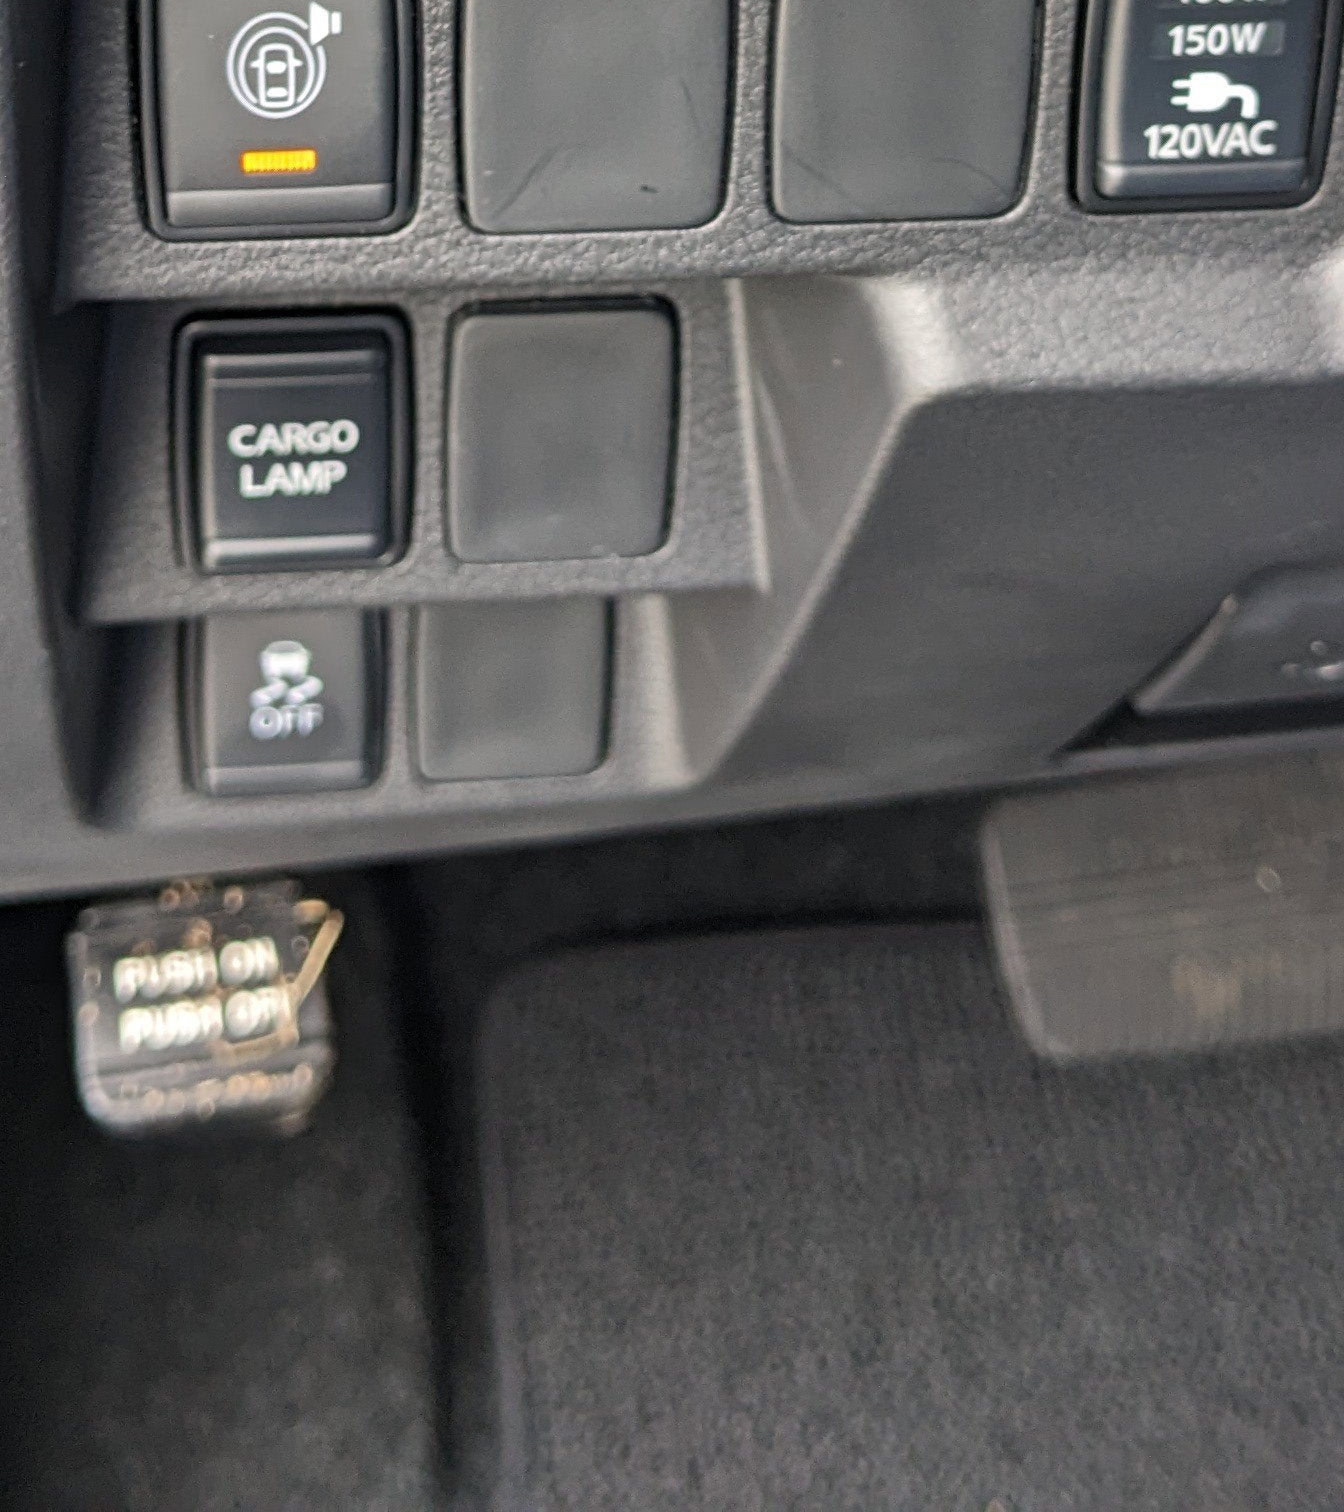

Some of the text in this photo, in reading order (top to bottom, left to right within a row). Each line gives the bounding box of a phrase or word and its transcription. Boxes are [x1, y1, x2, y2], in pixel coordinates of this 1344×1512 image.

[1168, 21, 1268, 57] 150W
[1143, 119, 1279, 160] 120VAC
[228, 419, 360, 459] CARGO
[239, 459, 348, 499] LAMP
[248, 702, 325, 740] OFF
